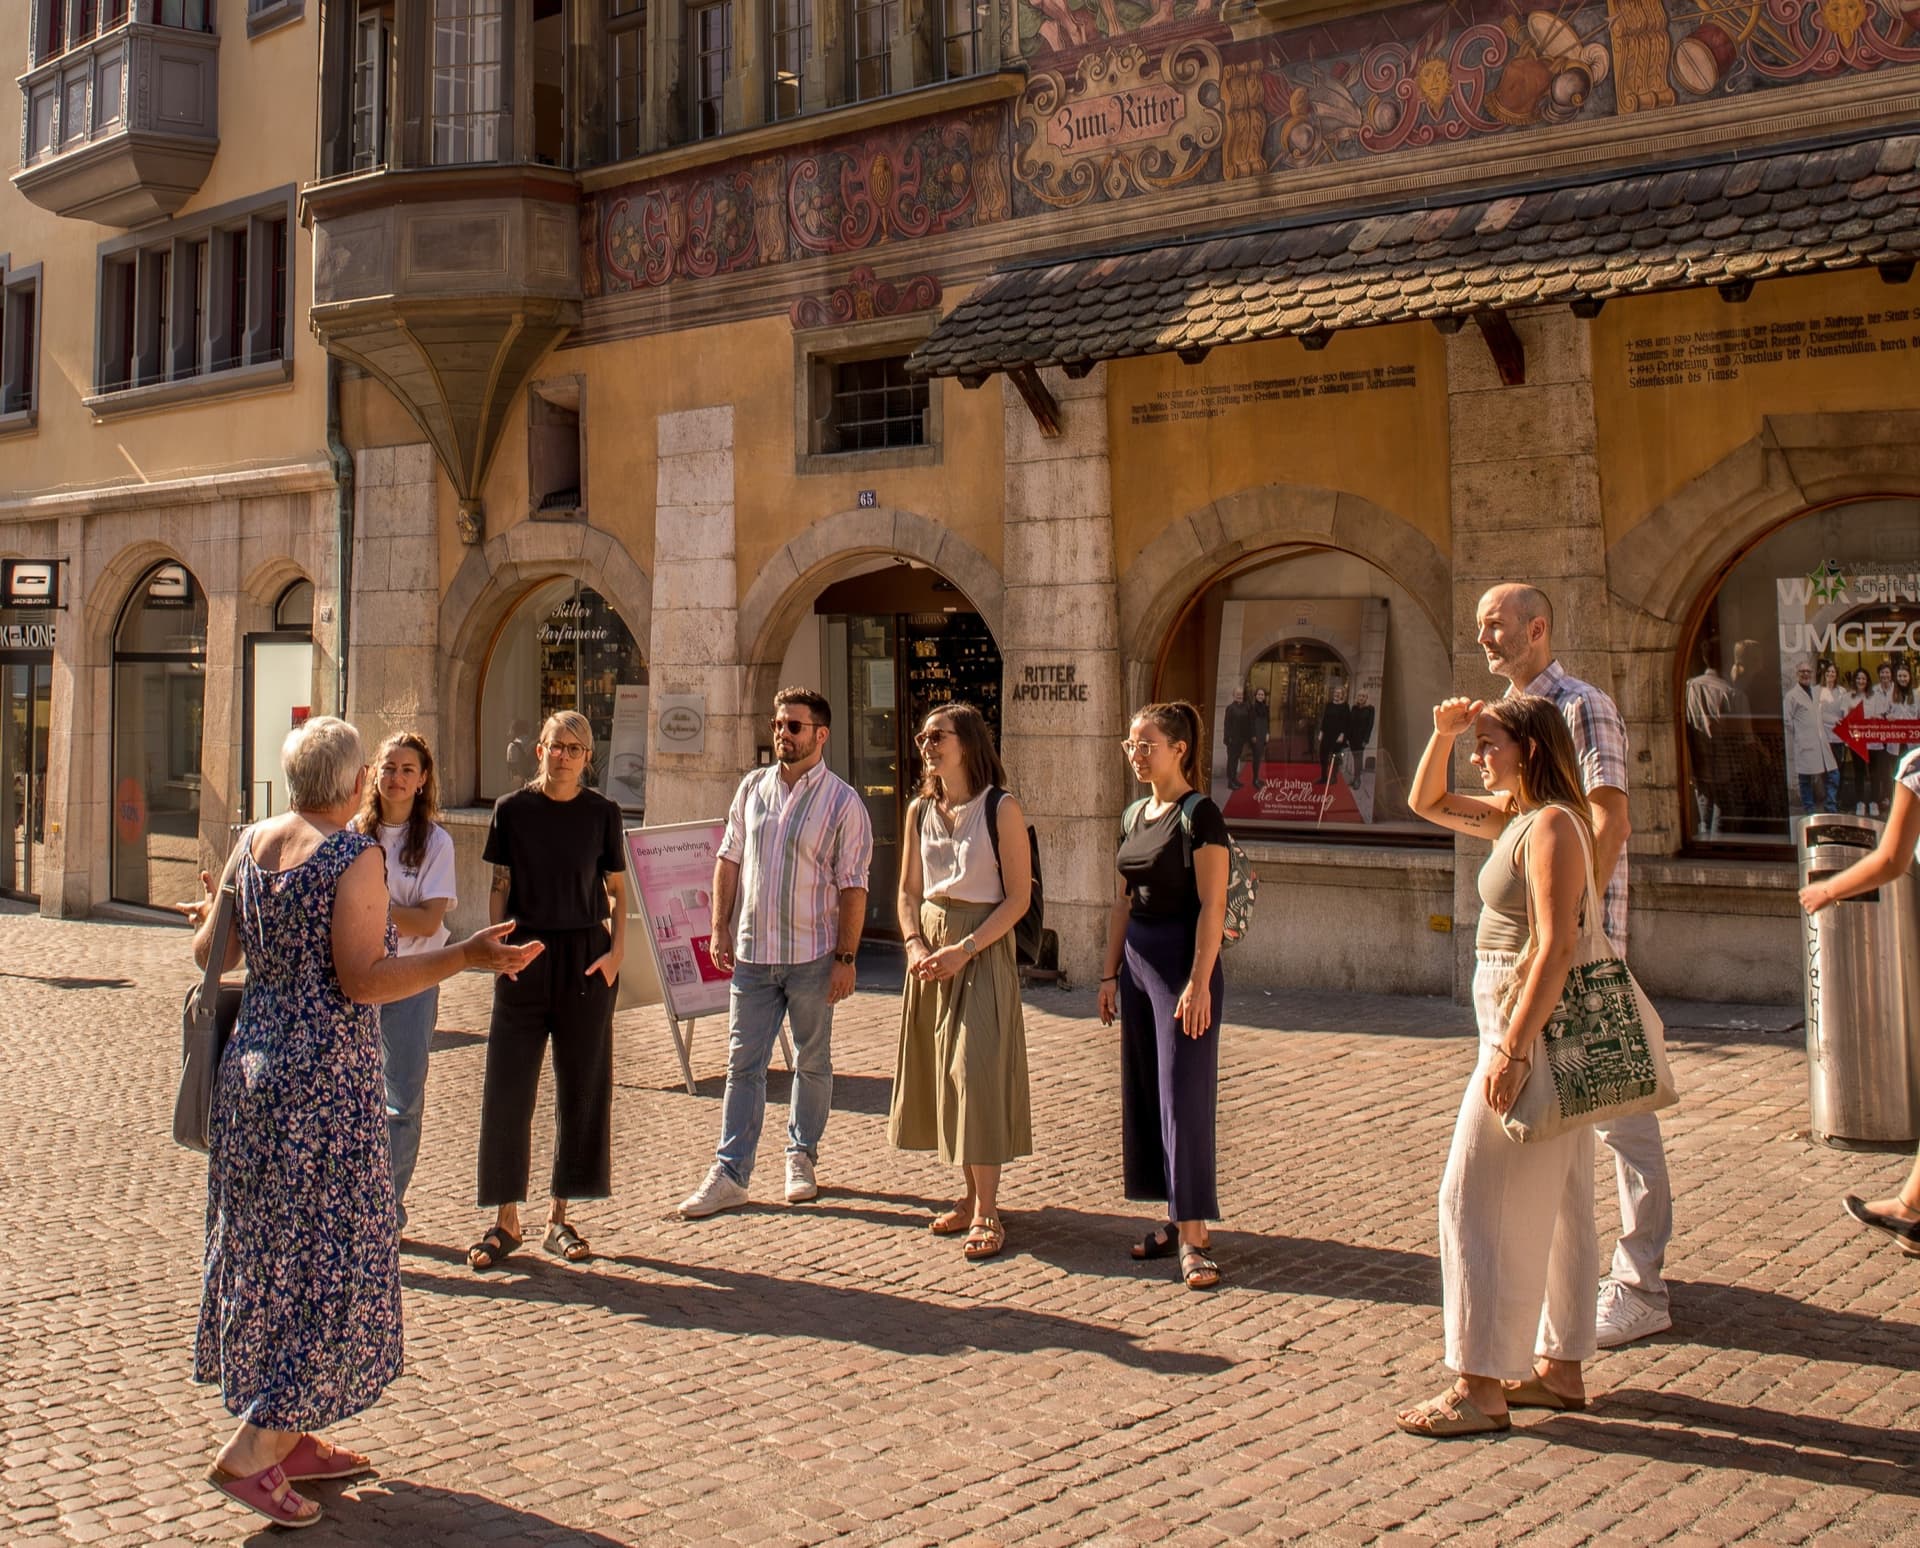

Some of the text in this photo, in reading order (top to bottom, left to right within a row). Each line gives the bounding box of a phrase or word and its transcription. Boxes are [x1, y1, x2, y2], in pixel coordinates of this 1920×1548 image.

[1058, 93, 1180, 149] Zum Ritter
[860, 492, 874, 507] 65
[1857, 574, 1920, 604] SIN
[551, 601, 592, 619] Ritter
[23, 625, 56, 648] JONE
[536, 622, 609, 646] Parfümerie
[1024, 665, 1076, 682] RITTER
[1012, 684, 1088, 702] APOTHEKE
[1265, 777, 1312, 792] Wir halten
[1275, 786, 1336, 811] Stellung
